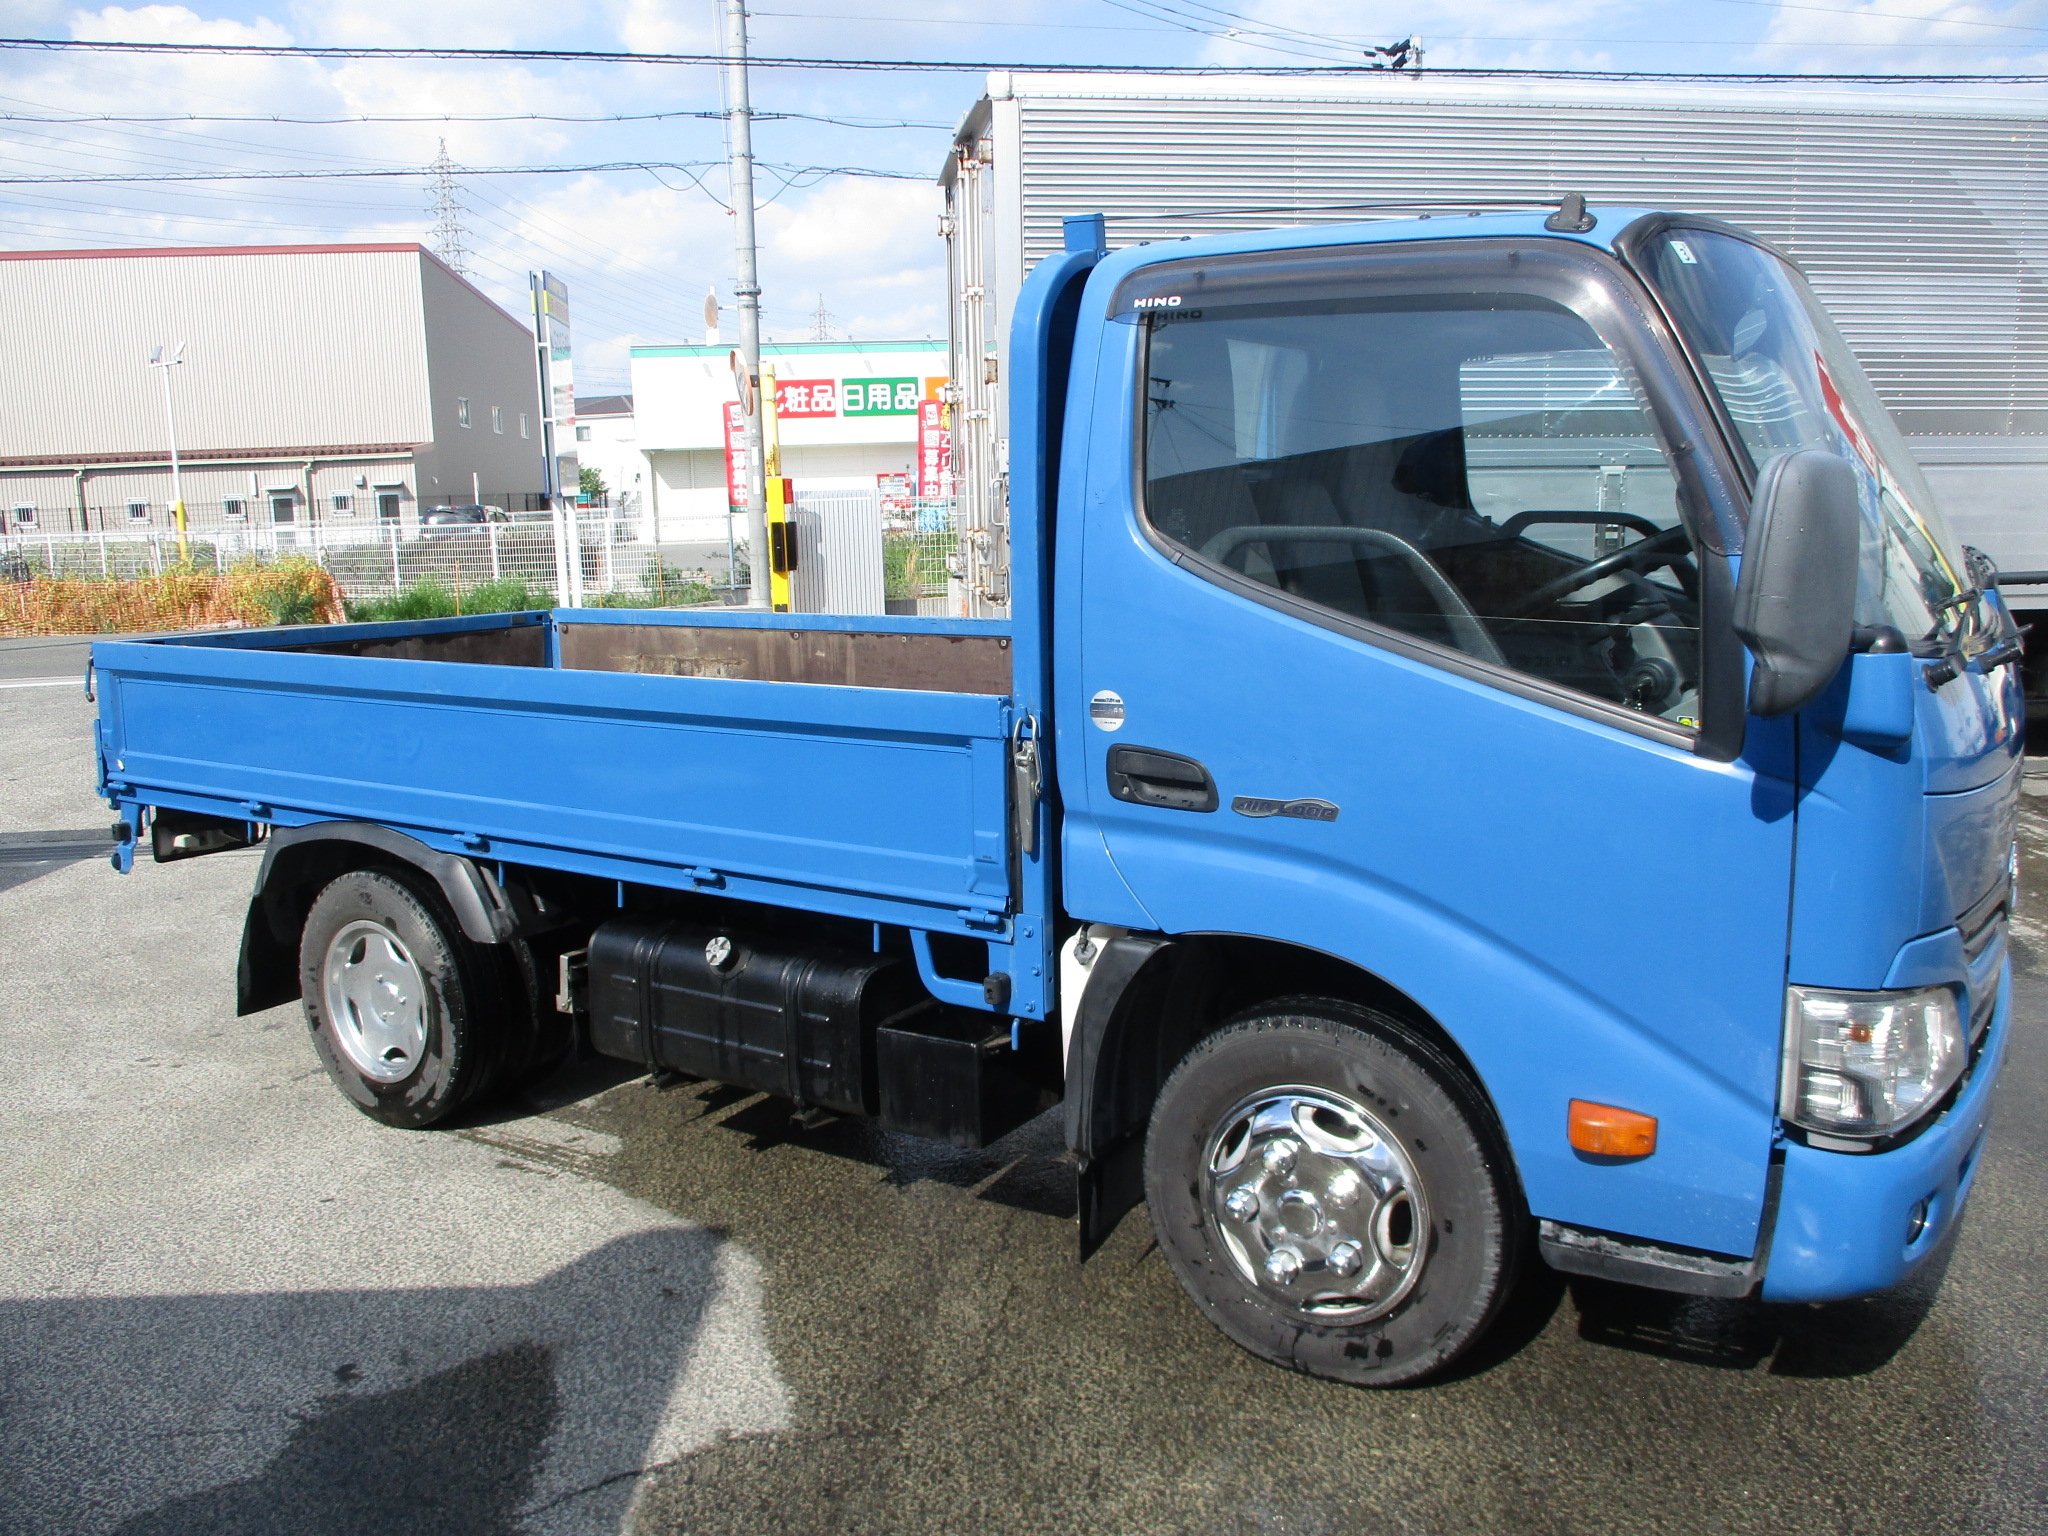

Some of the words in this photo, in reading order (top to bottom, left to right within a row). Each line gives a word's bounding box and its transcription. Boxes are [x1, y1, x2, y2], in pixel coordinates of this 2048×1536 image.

[1133, 295, 1182, 308] HINO
[843, 383, 919, 411] 日用品
[924, 449, 939, 499] 募集中
